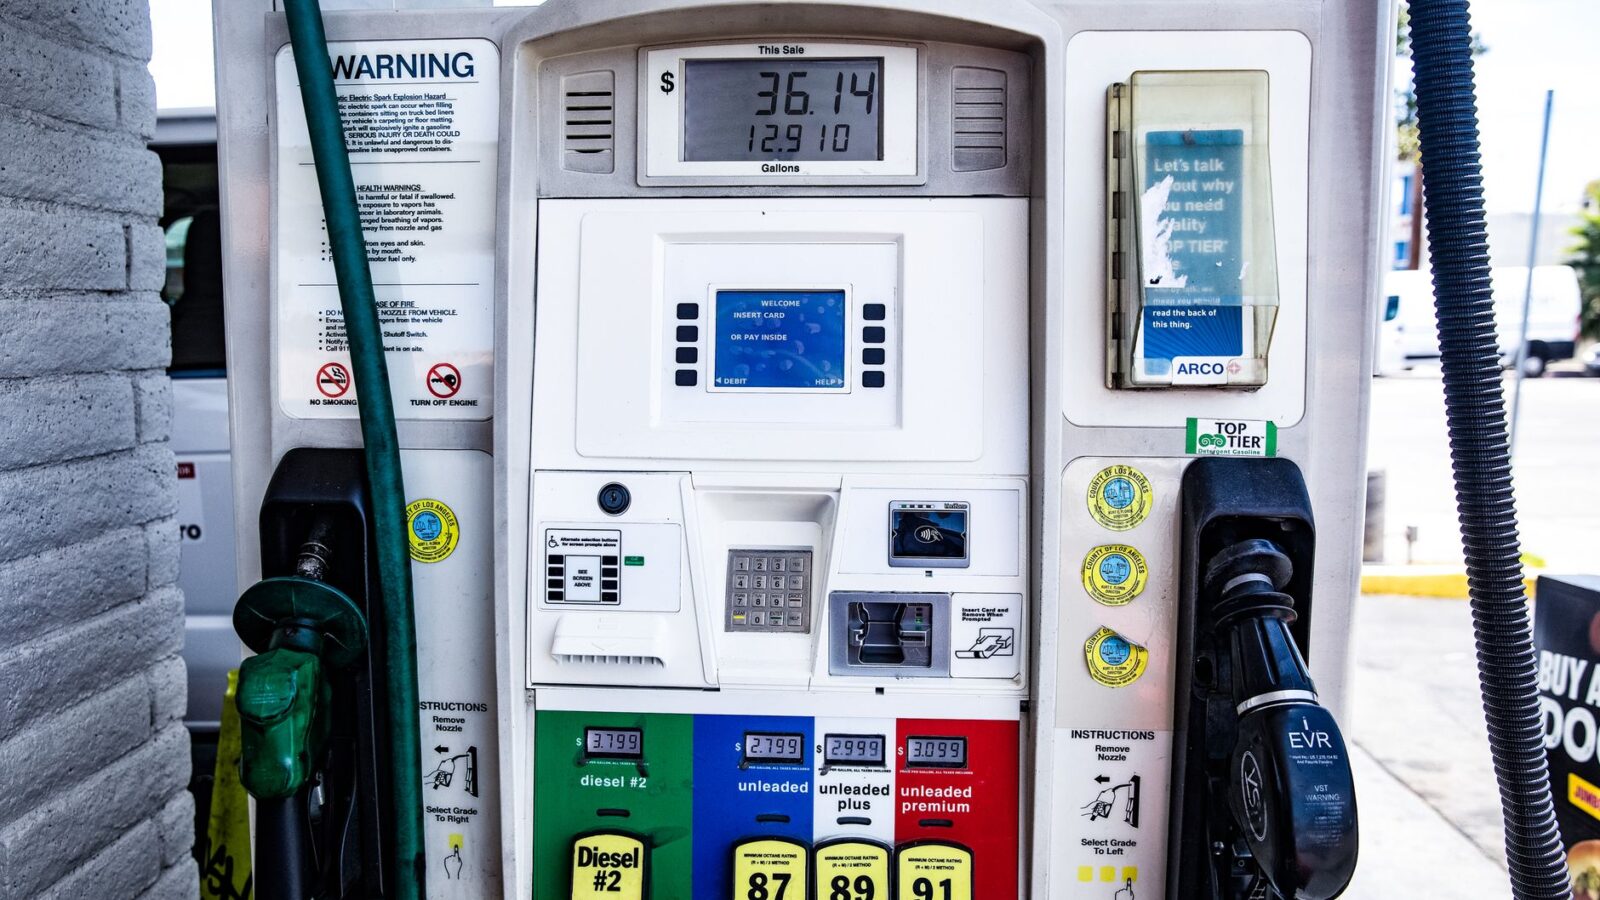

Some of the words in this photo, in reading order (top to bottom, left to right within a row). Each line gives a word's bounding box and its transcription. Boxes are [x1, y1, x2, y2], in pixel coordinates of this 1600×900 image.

[758, 46, 780, 54] This
[783, 46, 805, 54] Sale
[328, 52, 474, 80] WARNING
[660, 71, 675, 95] $
[393, 93, 422, 101] Explosion
[755, 71, 876, 116] 36.14
[749, 124, 850, 153] 12.910
[761, 163, 800, 173] Gallons
[1154, 158, 1190, 172] Let's
[1194, 158, 1224, 172] talk
[1202, 179, 1234, 194] why
[1185, 199, 1224, 211] need
[1169, 321, 1193, 330] thing.
[1177, 363, 1224, 375] ARCO
[1215, 422, 1247, 435] TOP
[1089, 474, 1105, 499] COUNTY
[1104, 469, 1113, 478] OF
[1114, 467, 1127, 475] LOS
[1127, 470, 1149, 494] ANGELES
[434, 504, 456, 527] ANGELES
[1086, 549, 1103, 570] COUNTY
[1127, 549, 1145, 574] ANGELES
[1086, 632, 1102, 653] COUNTY
[1538, 650, 1588, 701] BUY
[419, 701, 488, 712] STRUCTIONS
[432, 716, 465, 724] Remove
[1071, 730, 1155, 740] INSTRUCTIONS
[1538, 695, 1600, 765] DO
[576, 737, 582, 747] $
[735, 742, 741, 752] $
[750, 738, 798, 754] 2.799
[1288, 732, 1332, 748] EVR
[816, 744, 823, 754] $
[832, 740, 879, 757] 2.999
[897, 746, 904, 756] $
[913, 741, 960, 758] 3.099
[1095, 745, 1130, 753] Remove
[1097, 753, 1127, 761] Nozzle
[580, 774, 624, 787] diesel
[629, 776, 647, 789] #2
[738, 780, 809, 793] unleaded
[819, 783, 890, 796] unleaded
[900, 785, 972, 798] unleaded
[426, 806, 451, 814] Select
[453, 807, 478, 815] Grade
[838, 798, 871, 812] plus
[902, 800, 970, 814] premium
[447, 815, 469, 824] Right
[1081, 839, 1108, 847] Select
[1110, 839, 1137, 847] Grade
[577, 846, 639, 868] Diesel
[593, 870, 621, 892] #2
[747, 872, 792, 900] 87
[830, 875, 875, 900] 89
[912, 877, 951, 900] 91
